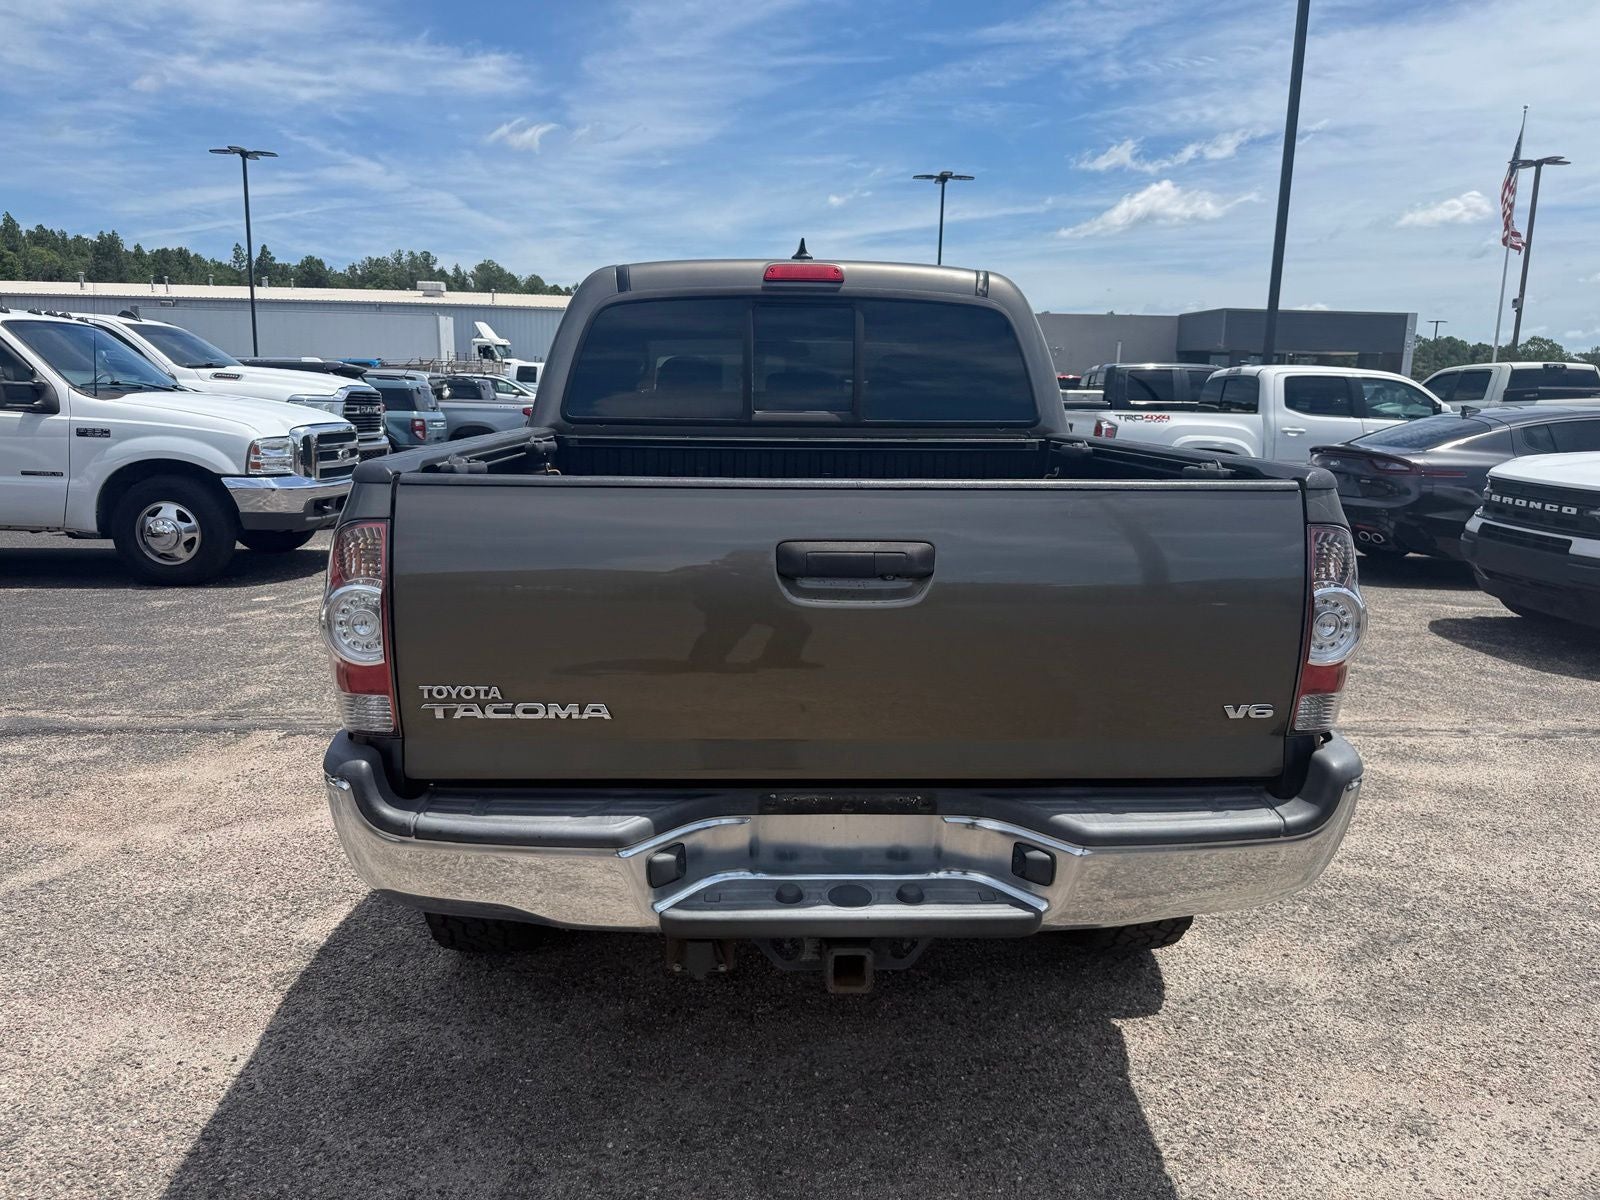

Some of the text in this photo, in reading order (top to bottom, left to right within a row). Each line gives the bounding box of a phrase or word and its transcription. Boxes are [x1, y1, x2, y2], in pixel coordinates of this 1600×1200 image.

[1491, 494, 1577, 515] BRONCO
[418, 685, 503, 700] TOYOTA
[420, 703, 612, 720] TACOMA
[1223, 703, 1274, 719] V6
